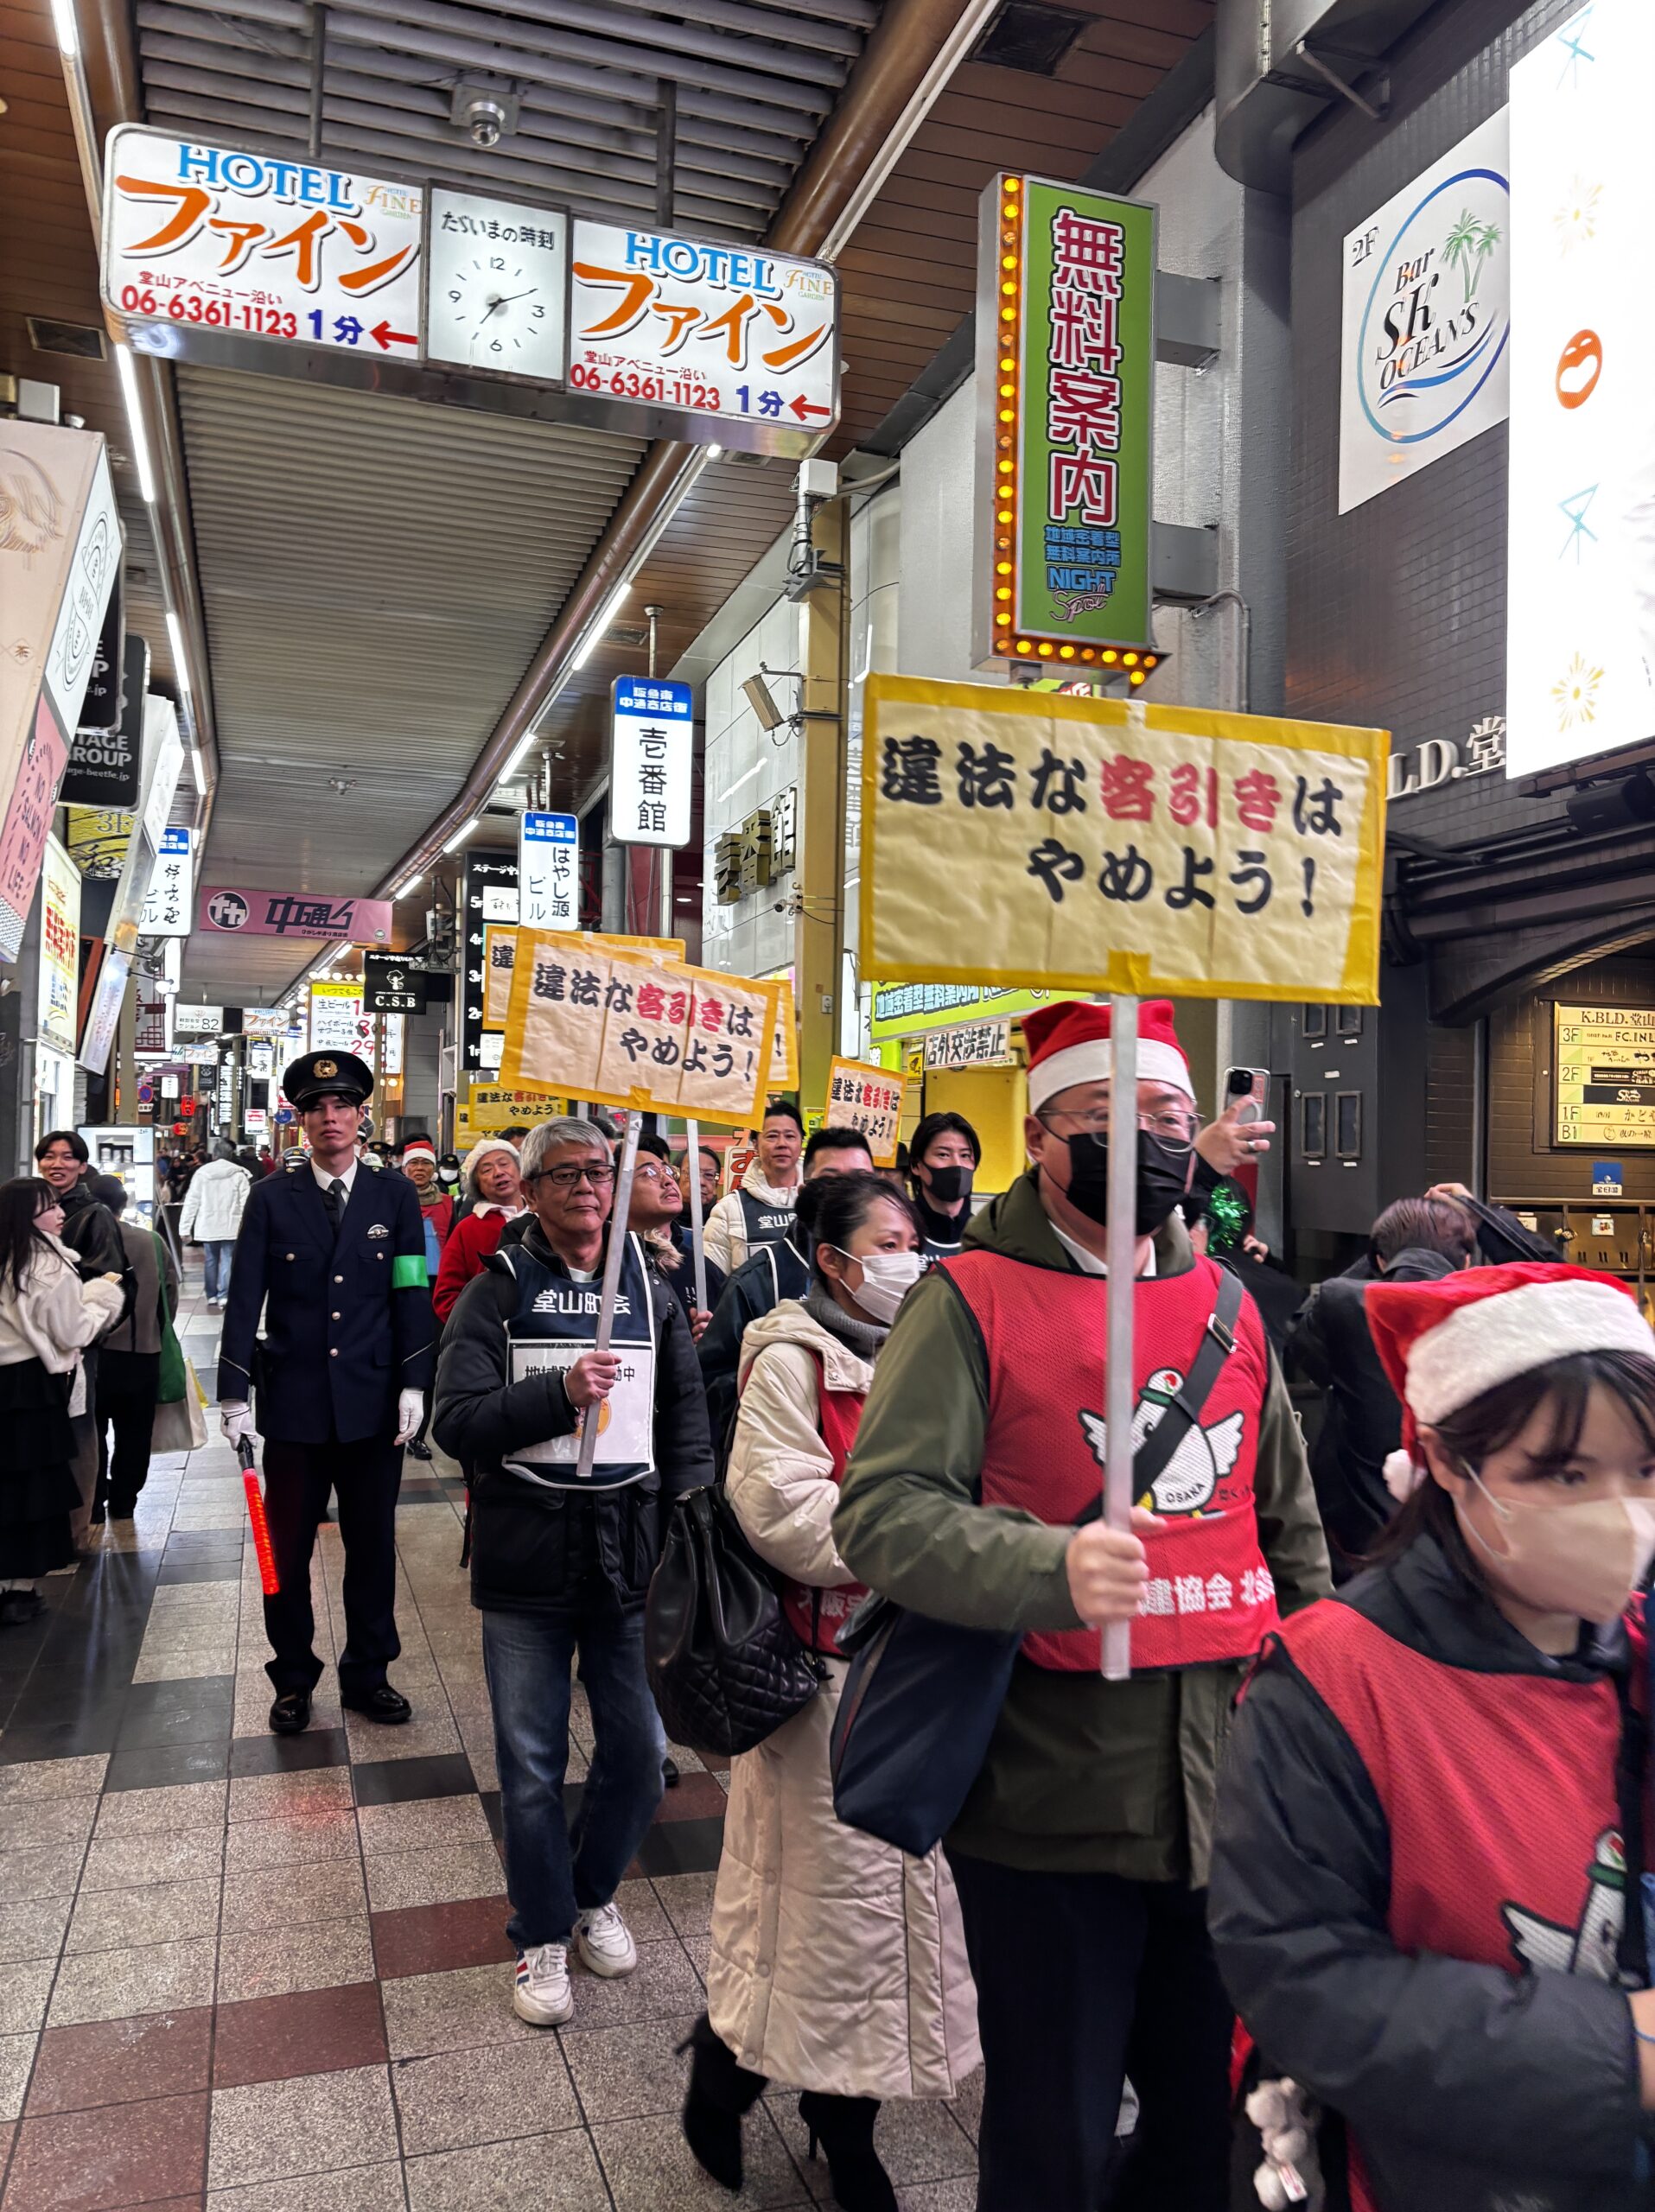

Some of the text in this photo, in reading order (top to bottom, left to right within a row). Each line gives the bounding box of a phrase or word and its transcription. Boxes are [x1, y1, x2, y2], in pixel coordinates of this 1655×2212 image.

[177, 143, 355, 210] HOTEL
[115, 174, 413, 290] ファイン
[490, 257, 506, 271] 12
[625, 232, 777, 294] HOTEL
[1393, 247, 1435, 295] Bar
[137, 270, 283, 306] 堂山アベニュー沿い
[449, 290, 461, 304] 9
[121, 284, 298, 339] 06-6361-1123
[307, 308, 365, 346] 1分
[532, 304, 546, 319] 3
[573, 260, 826, 367] ファイン
[490, 339, 503, 353] 6
[584, 350, 707, 381] 堂山アベニュー沿い
[1049, 207, 1124, 526] 無料案内
[570, 364, 721, 410] 06-6361-1123
[735, 385, 786, 417] 1分
[1047, 565, 1117, 594] NIGHT
[638, 728, 667, 832] 壱番館
[880, 734, 1345, 837] 違法な客引きは
[97, 812, 134, 833] 3F
[551, 847, 570, 918] はやし源
[1025, 837, 1318, 920] やめよう！
[529, 875, 546, 920] ビル
[375, 995, 416, 1007] C.S.B
[468, 1007, 482, 1020] 2F
[534, 963, 754, 1038] 違法な客引きは
[201, 1018, 220, 1030] 82
[1563, 1027, 1580, 1042] 3F
[620, 1027, 754, 1084] やめよう！
[927, 1024, 1005, 1066] 店外交渉禁止
[1563, 1066, 1581, 1082] 2F
[831, 1077, 900, 1112] 違法な客引きは
[1563, 1106, 1581, 1121] 1F
[1563, 1125, 1577, 1140] B1
[758, 1213, 798, 1229] 堂山
[1166, 1483, 1206, 1503] OSAKA
